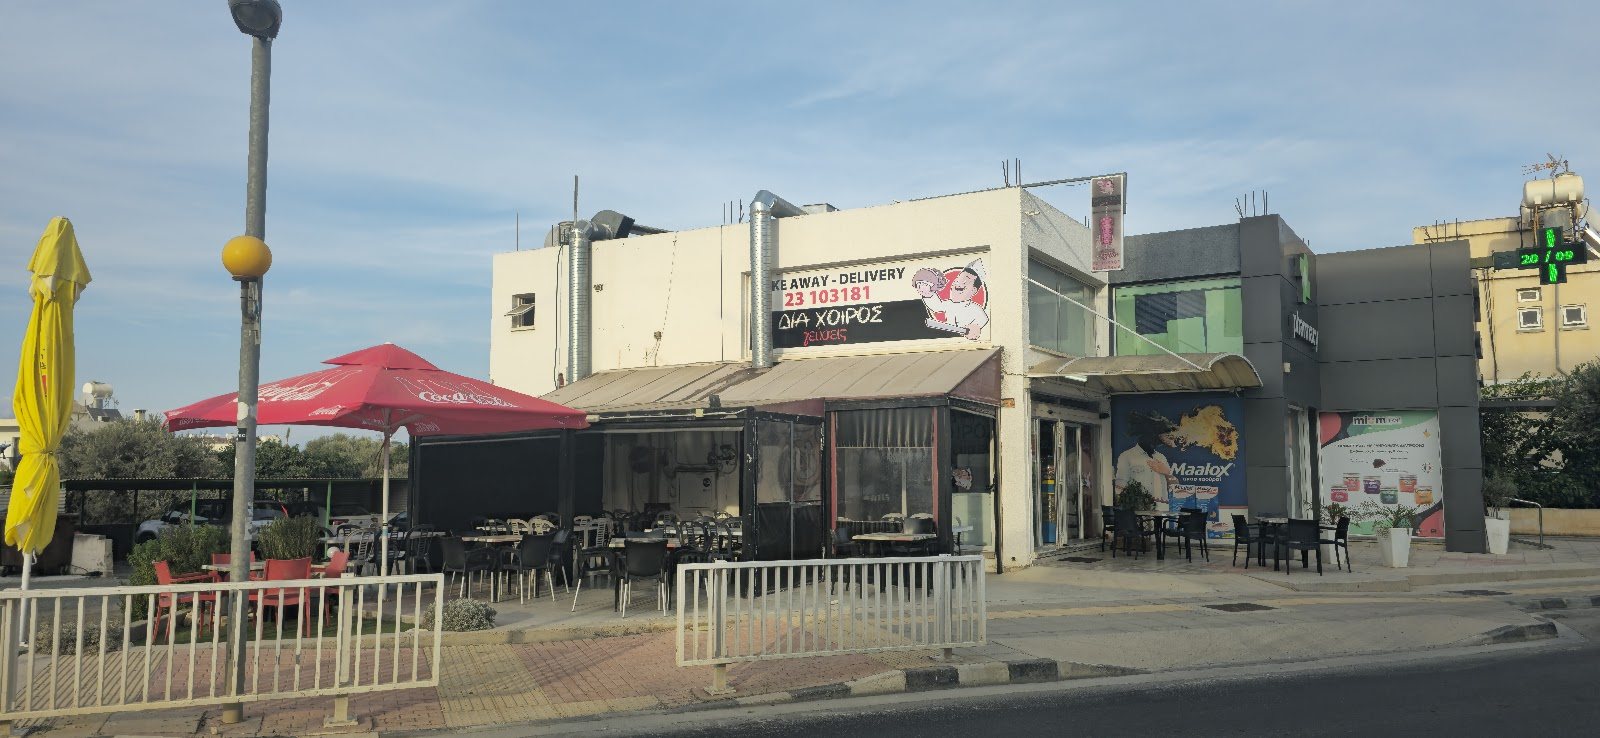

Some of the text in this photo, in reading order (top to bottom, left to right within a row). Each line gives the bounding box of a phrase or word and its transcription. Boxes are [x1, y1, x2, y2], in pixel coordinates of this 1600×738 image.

[789, 275, 830, 289] AWAY
[839, 267, 906, 285] DELIVERY
[784, 286, 870, 307] 23 103181
[1292, 310, 1319, 352] pharmacy
[1169, 462, 1233, 478] Maalox
